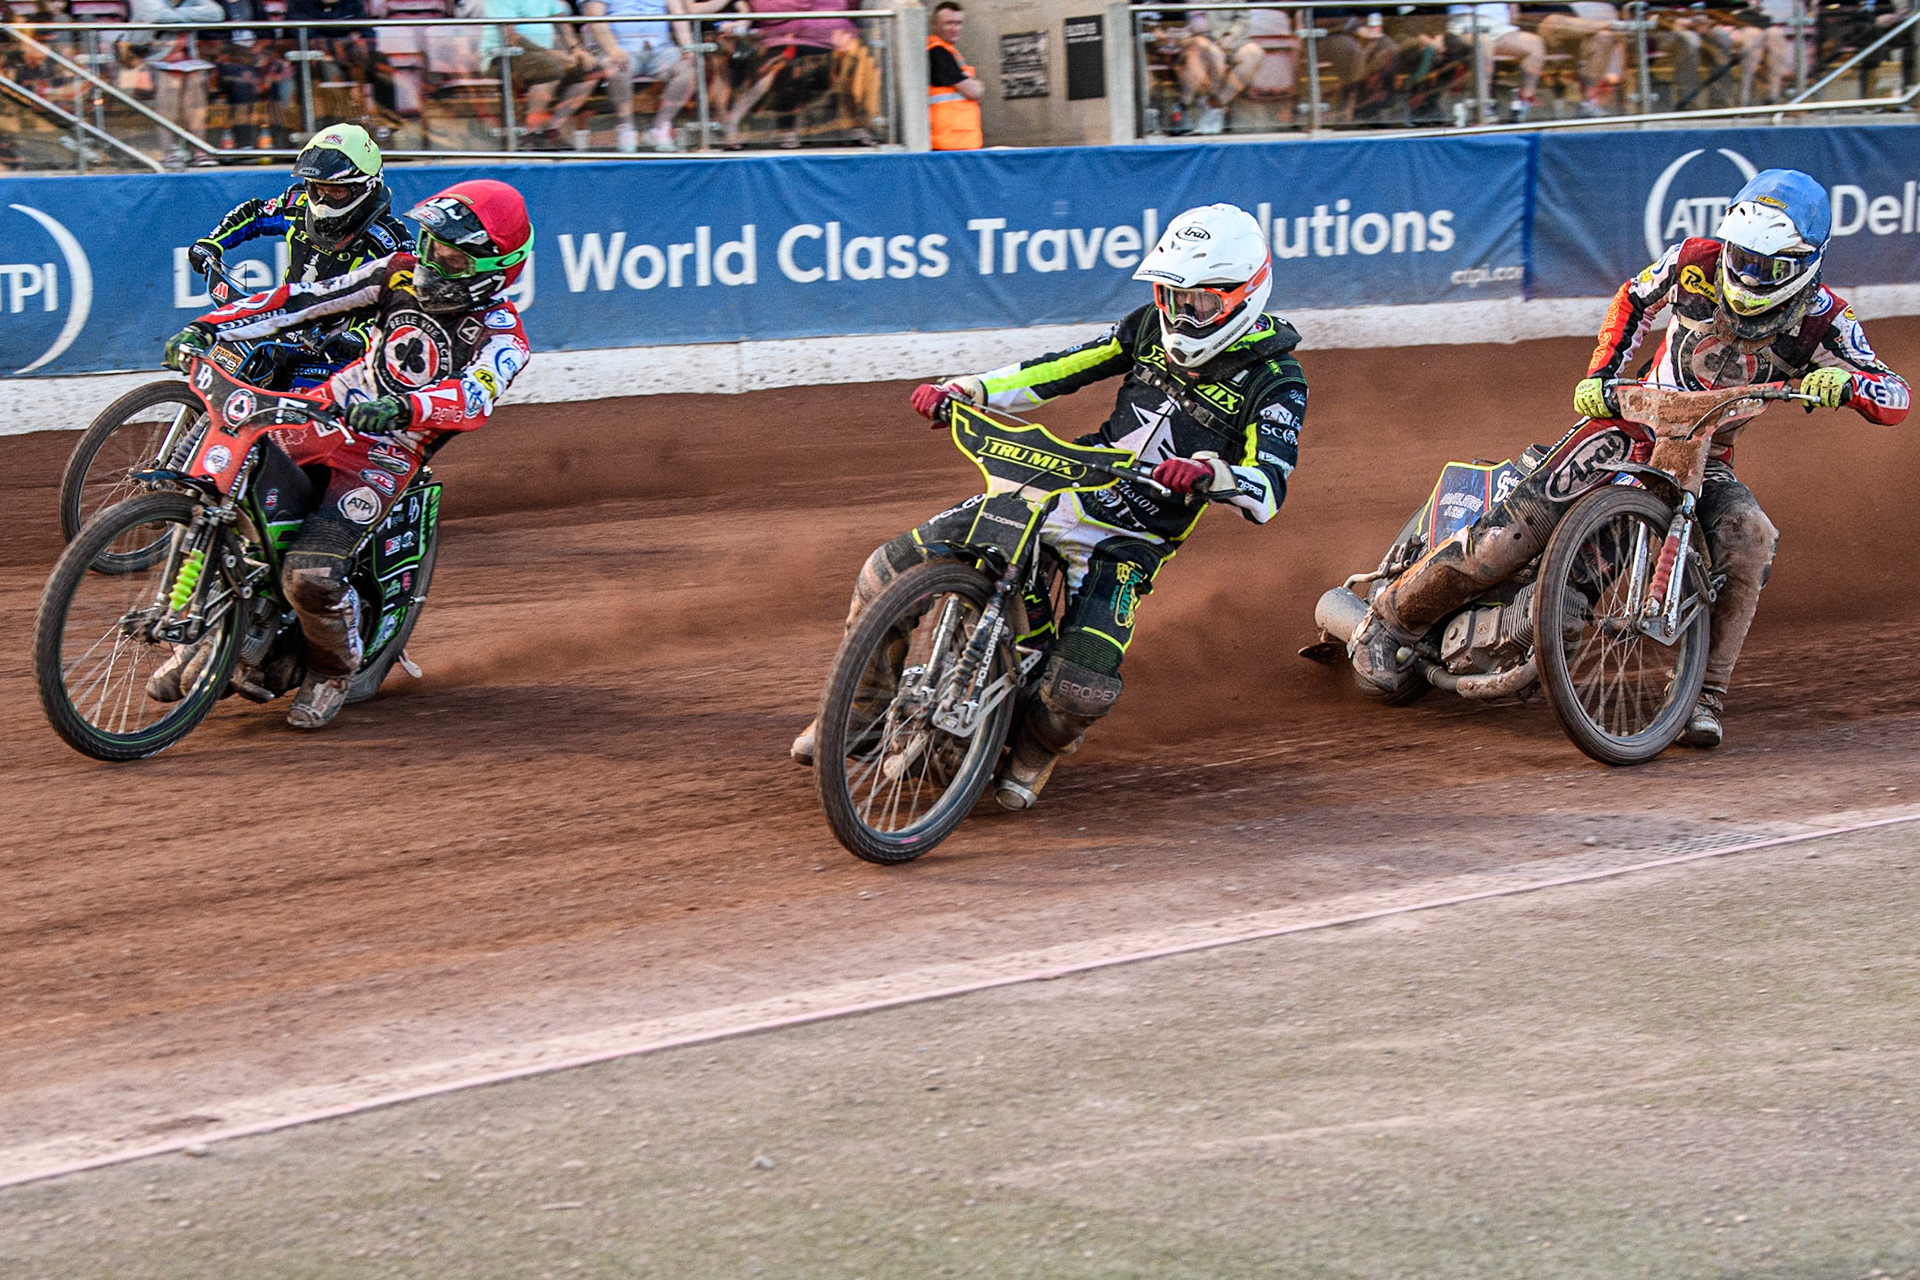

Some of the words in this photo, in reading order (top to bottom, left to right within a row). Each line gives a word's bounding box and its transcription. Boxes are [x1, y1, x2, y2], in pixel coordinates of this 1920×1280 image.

[558, 225, 757, 292] World
[777, 221, 949, 283] Class
[968, 209, 1158, 275] Travel
[1257, 199, 1456, 260] lutions
[390, 315, 418, 330] BELLE
[422, 320, 440, 339] VUE
[461, 325, 477, 341] 4
[989, 441, 1027, 461] TRU
[1029, 452, 1073, 476] MIX
[1560, 434, 1621, 495] Arai
[347, 496, 373, 515] ATPI
[976, 616, 1005, 688] POLCOPPER
